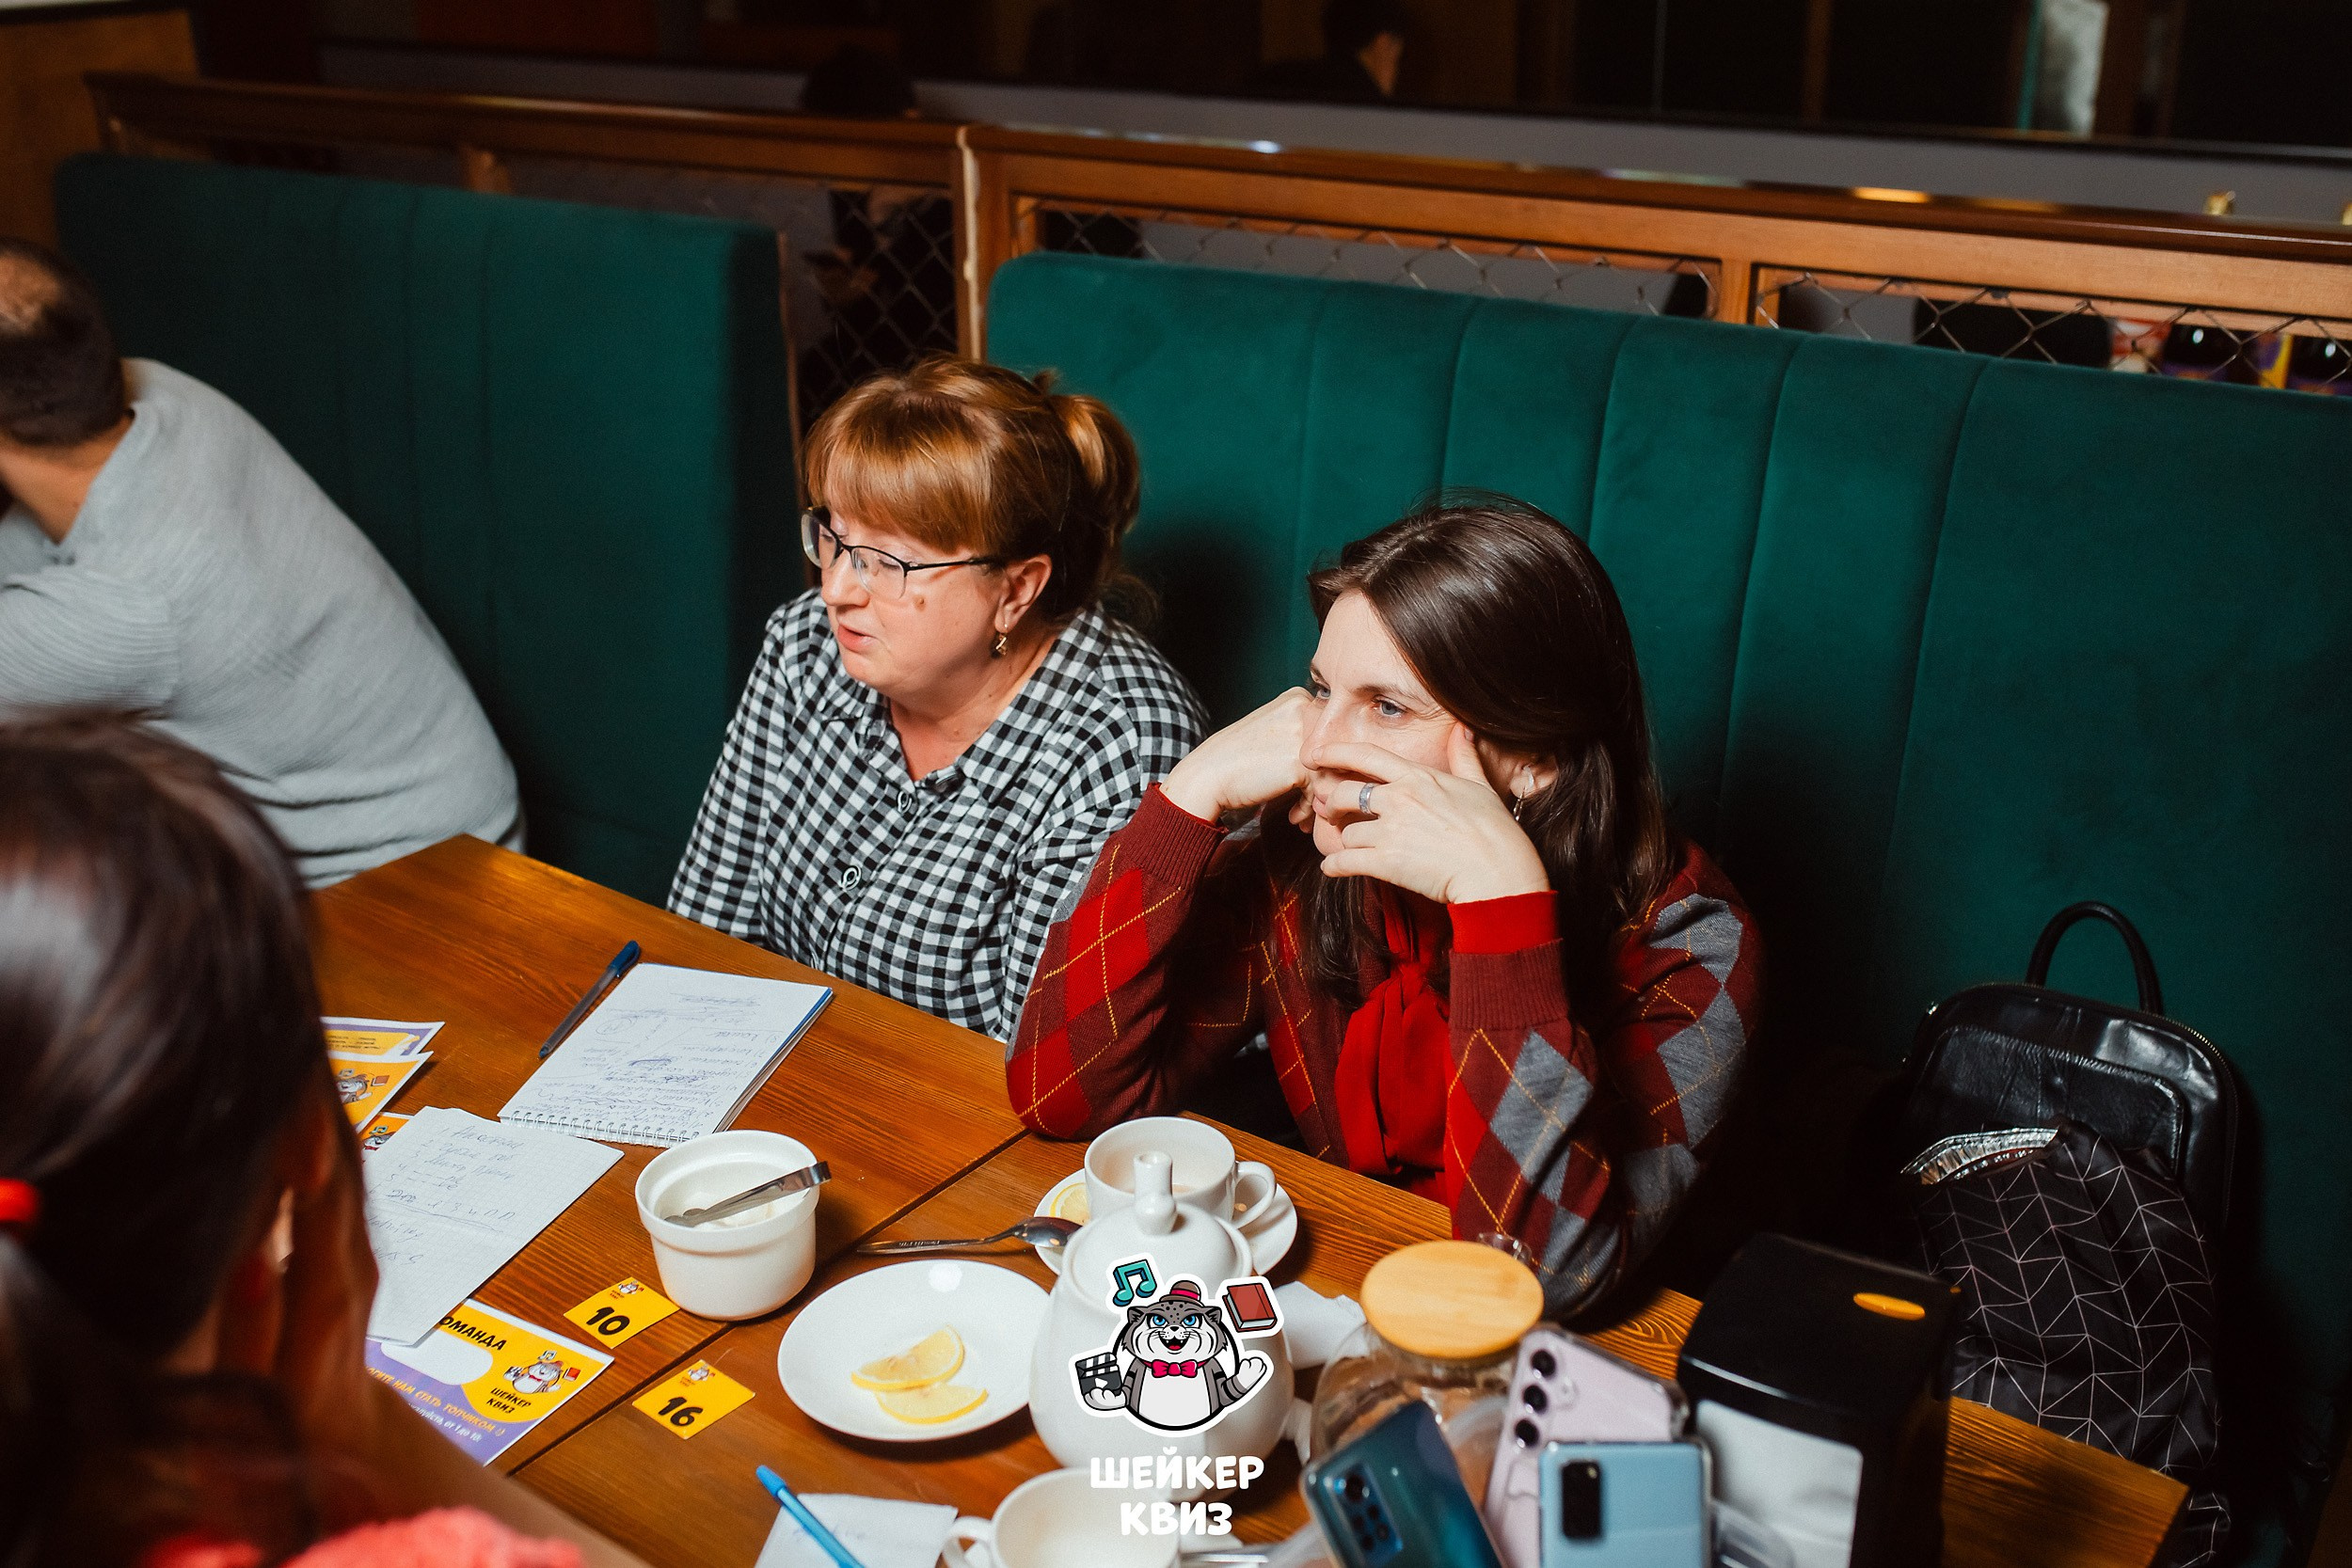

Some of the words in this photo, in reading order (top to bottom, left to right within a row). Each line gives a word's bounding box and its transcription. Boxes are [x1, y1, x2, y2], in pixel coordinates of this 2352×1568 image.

[438, 1316, 507, 1351] ОМАНДА
[585, 1307, 630, 1336] 10
[392, 1380, 416, 1395] НАМ
[415, 1390, 442, 1407] СТАТЬ
[486, 1398, 516, 1414] КВИЗ
[490, 1387, 532, 1407] ШЕЙКЕР
[658, 1397, 704, 1427] 16
